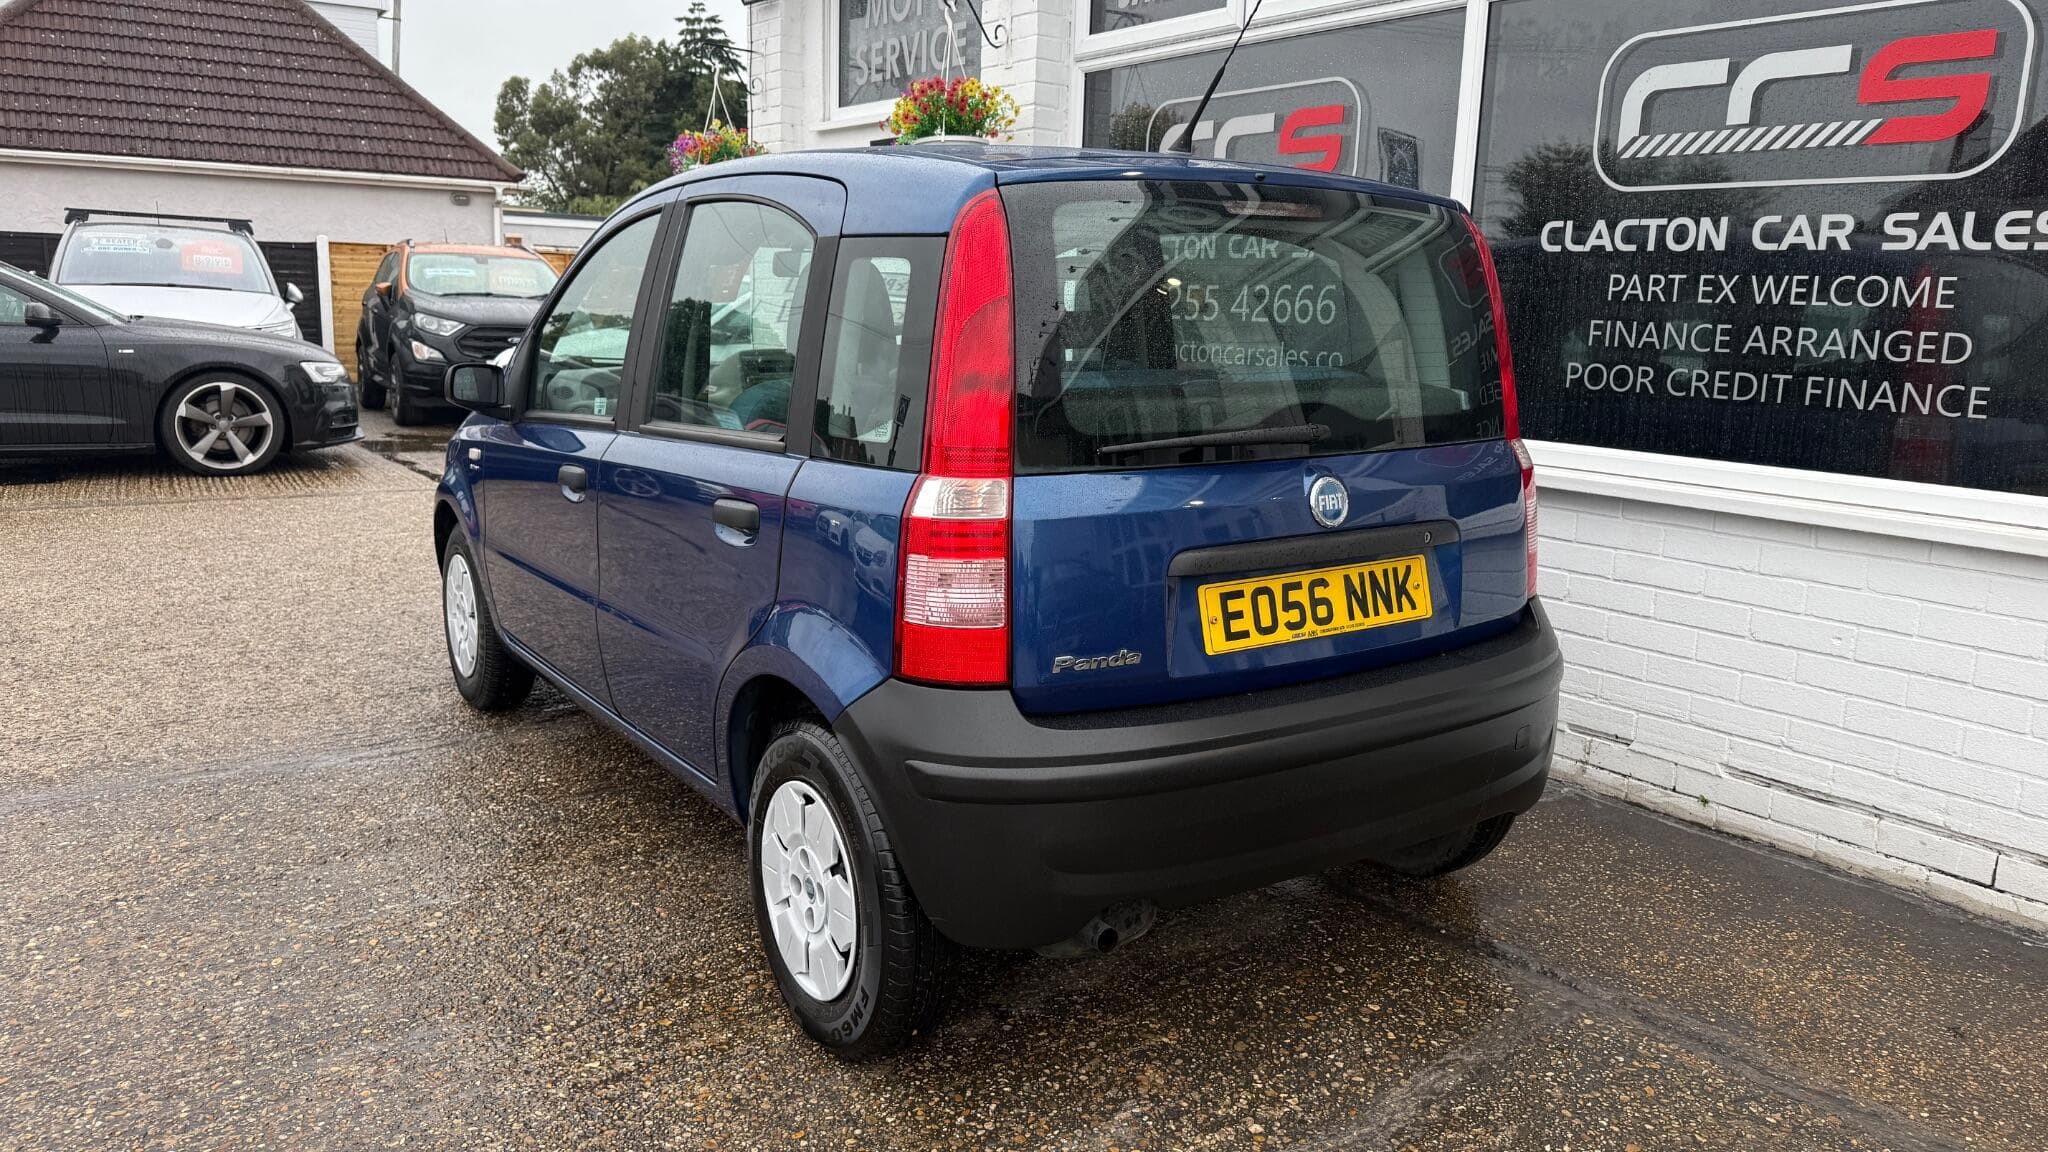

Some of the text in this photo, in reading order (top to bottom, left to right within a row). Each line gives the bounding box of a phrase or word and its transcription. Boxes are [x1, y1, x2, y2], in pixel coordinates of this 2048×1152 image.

[854, 21, 967, 86] SERVICE
[1228, 236, 1279, 259] CAR
[1540, 216, 1729, 252] CLACTON
[1751, 213, 1856, 251] CAR
[1230, 284, 1337, 325] 42666
[1607, 274, 1958, 309] PART EX WELCOME
[1174, 341, 1344, 367] ctoncarsales.co
[1588, 319, 1974, 365] FINANCE ARRANGED
[1565, 362, 1992, 420] POOR CREDIT FINANCE
[1318, 493, 1343, 512] FIAT
[1342, 564, 1418, 622] NNK
[1051, 649, 1142, 674] Panda
